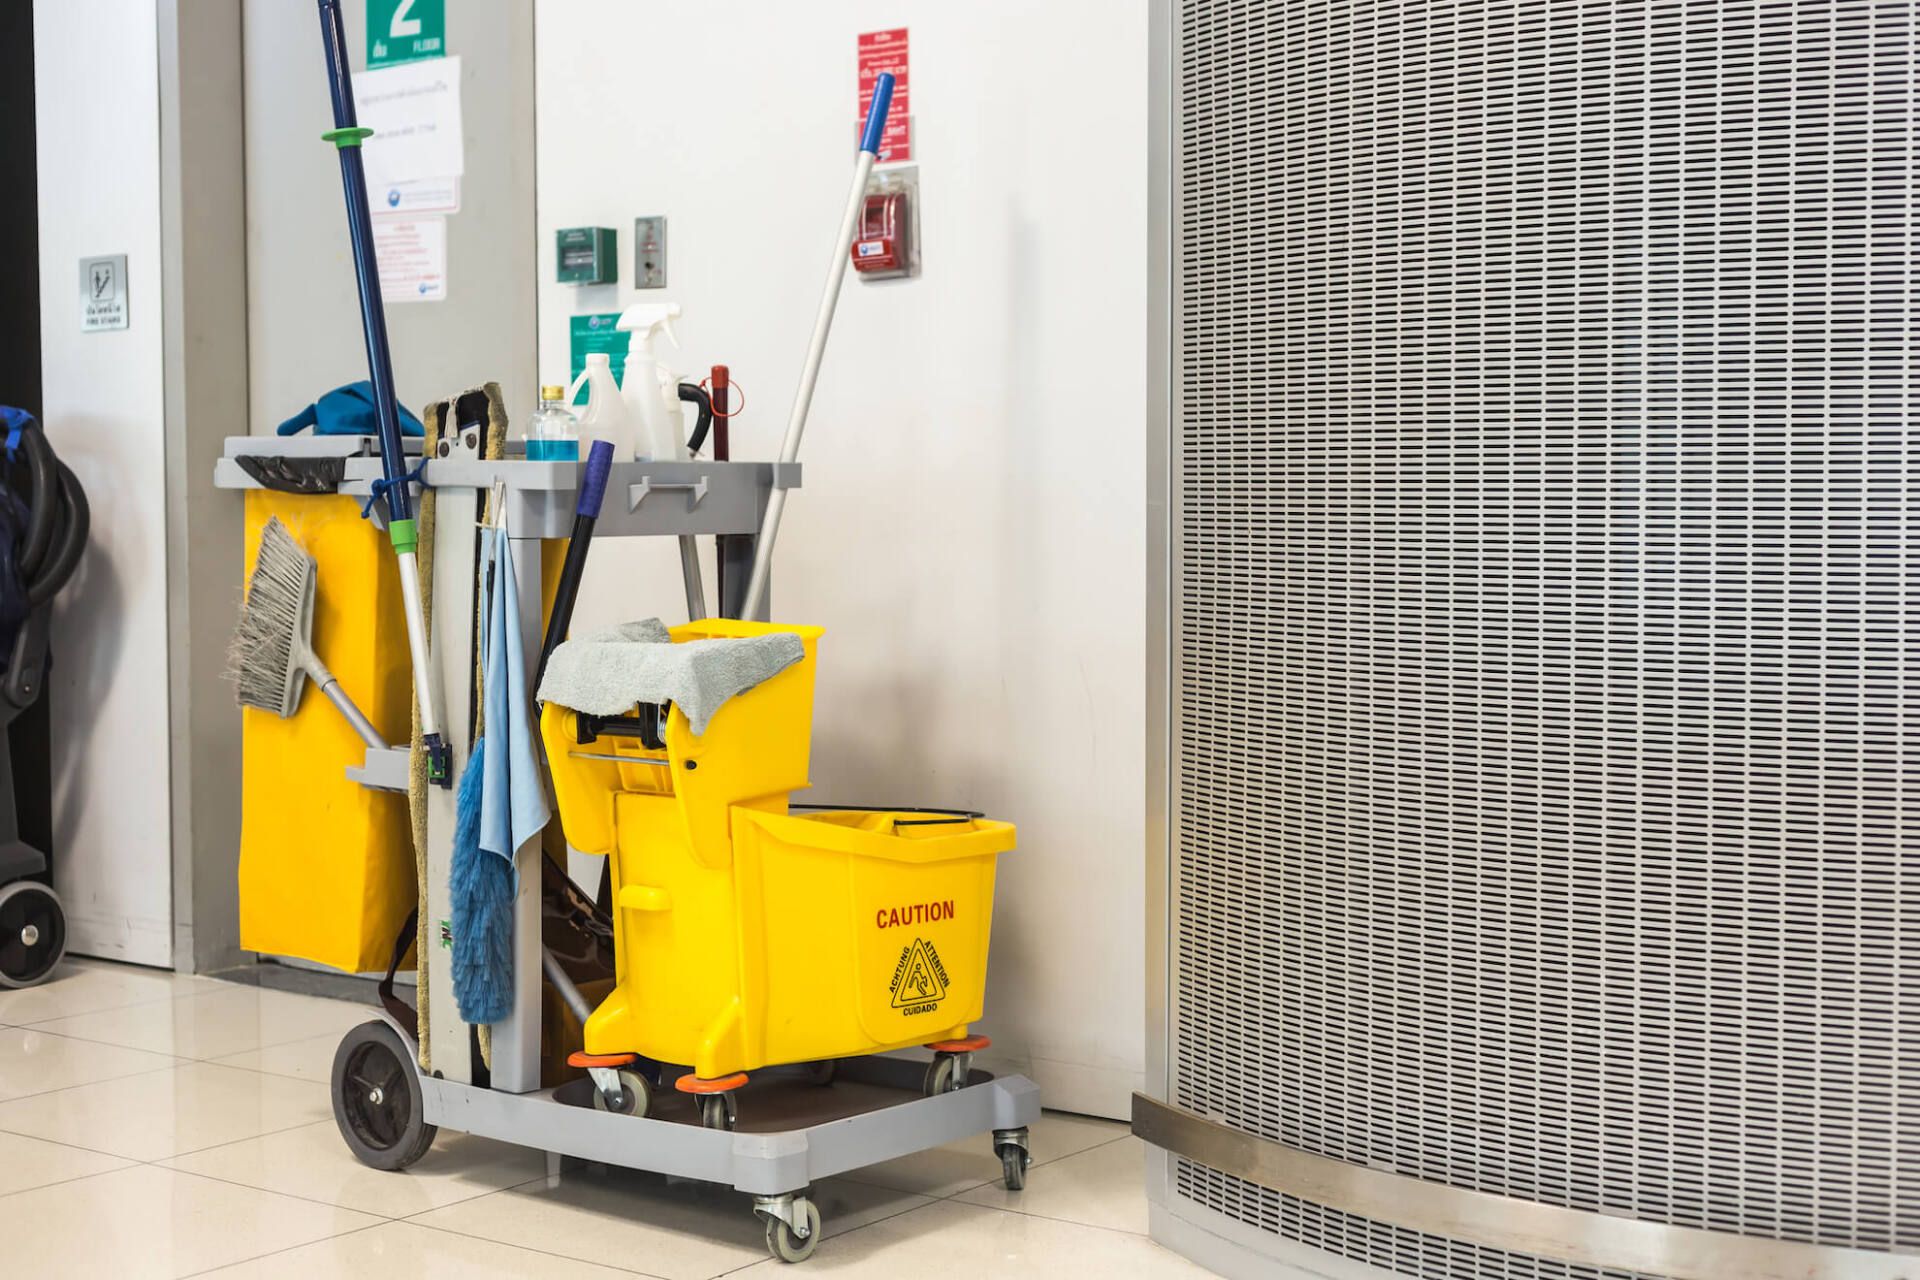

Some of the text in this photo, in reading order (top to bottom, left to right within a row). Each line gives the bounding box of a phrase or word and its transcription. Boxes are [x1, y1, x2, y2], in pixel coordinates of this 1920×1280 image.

[389, 0, 421, 38] 2
[413, 38, 440, 53] FLOOR
[876, 900, 955, 929] CAUTION
[889, 946, 910, 993] ACHTUNG
[924, 940, 951, 988] ATTENTION
[903, 1002, 938, 1017] CUIDADO
